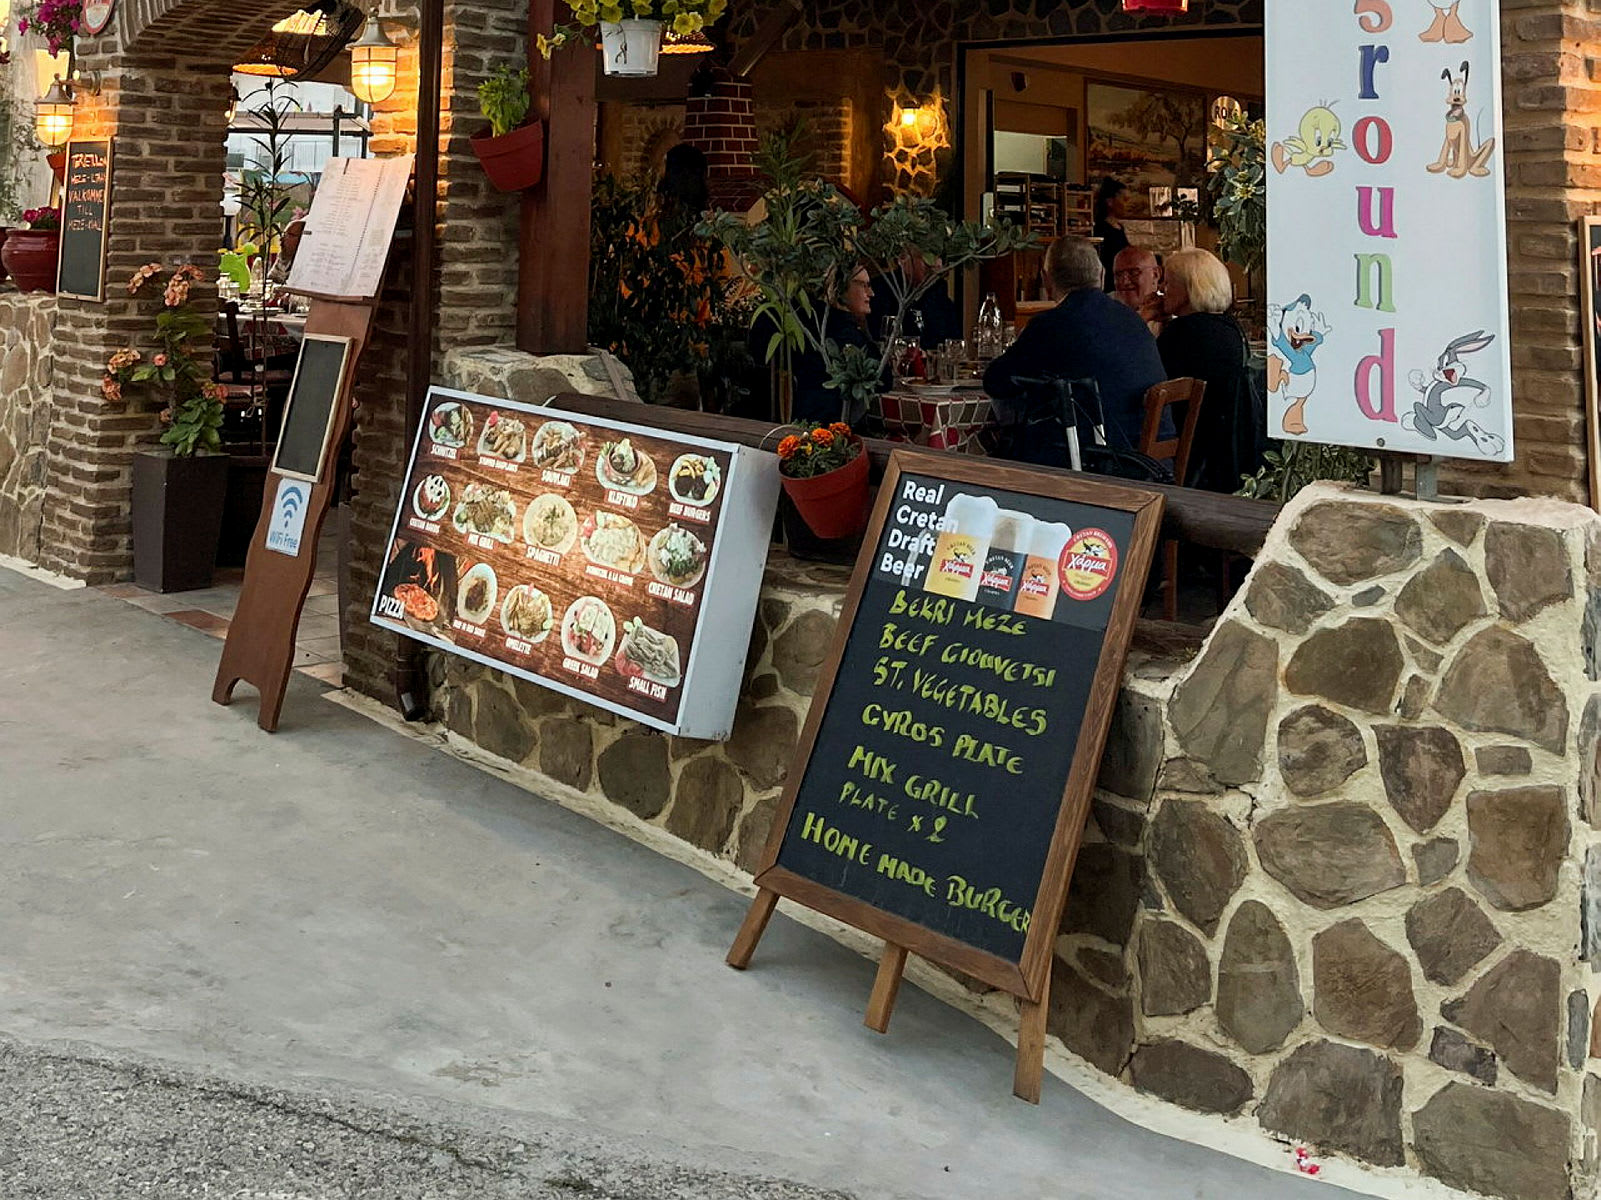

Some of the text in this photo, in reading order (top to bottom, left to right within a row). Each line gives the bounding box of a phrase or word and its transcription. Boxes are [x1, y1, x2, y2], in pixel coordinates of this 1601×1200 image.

[1214, 105, 1239, 120] ROK
[903, 480, 945, 505] Real
[682, 507, 711, 522] BURGERS
[897, 505, 959, 534] Cretan
[526, 545, 561, 566] SPAGHETTI
[888, 528, 935, 556] Draft
[880, 552, 924, 579] Beer
[1067, 553, 1107, 573] Χάρμα
[379, 594, 405, 619] PIZZA
[648, 582, 695, 606] CRETAN SALAD
[963, 606, 1027, 635] MEZE
[879, 622, 939, 656] BEEF
[580, 663, 599, 679] SALAD
[628, 676, 667, 700] SMALL FISH
[912, 668, 1047, 735] VEGETABLES
[862, 704, 1024, 774] GYROS PLATE
[848, 745, 979, 819] MIX GRILL
[839, 781, 900, 820] PLATE
[925, 815, 948, 843] 2
[801, 812, 873, 865] HOME
[877, 854, 936, 897] MADE
